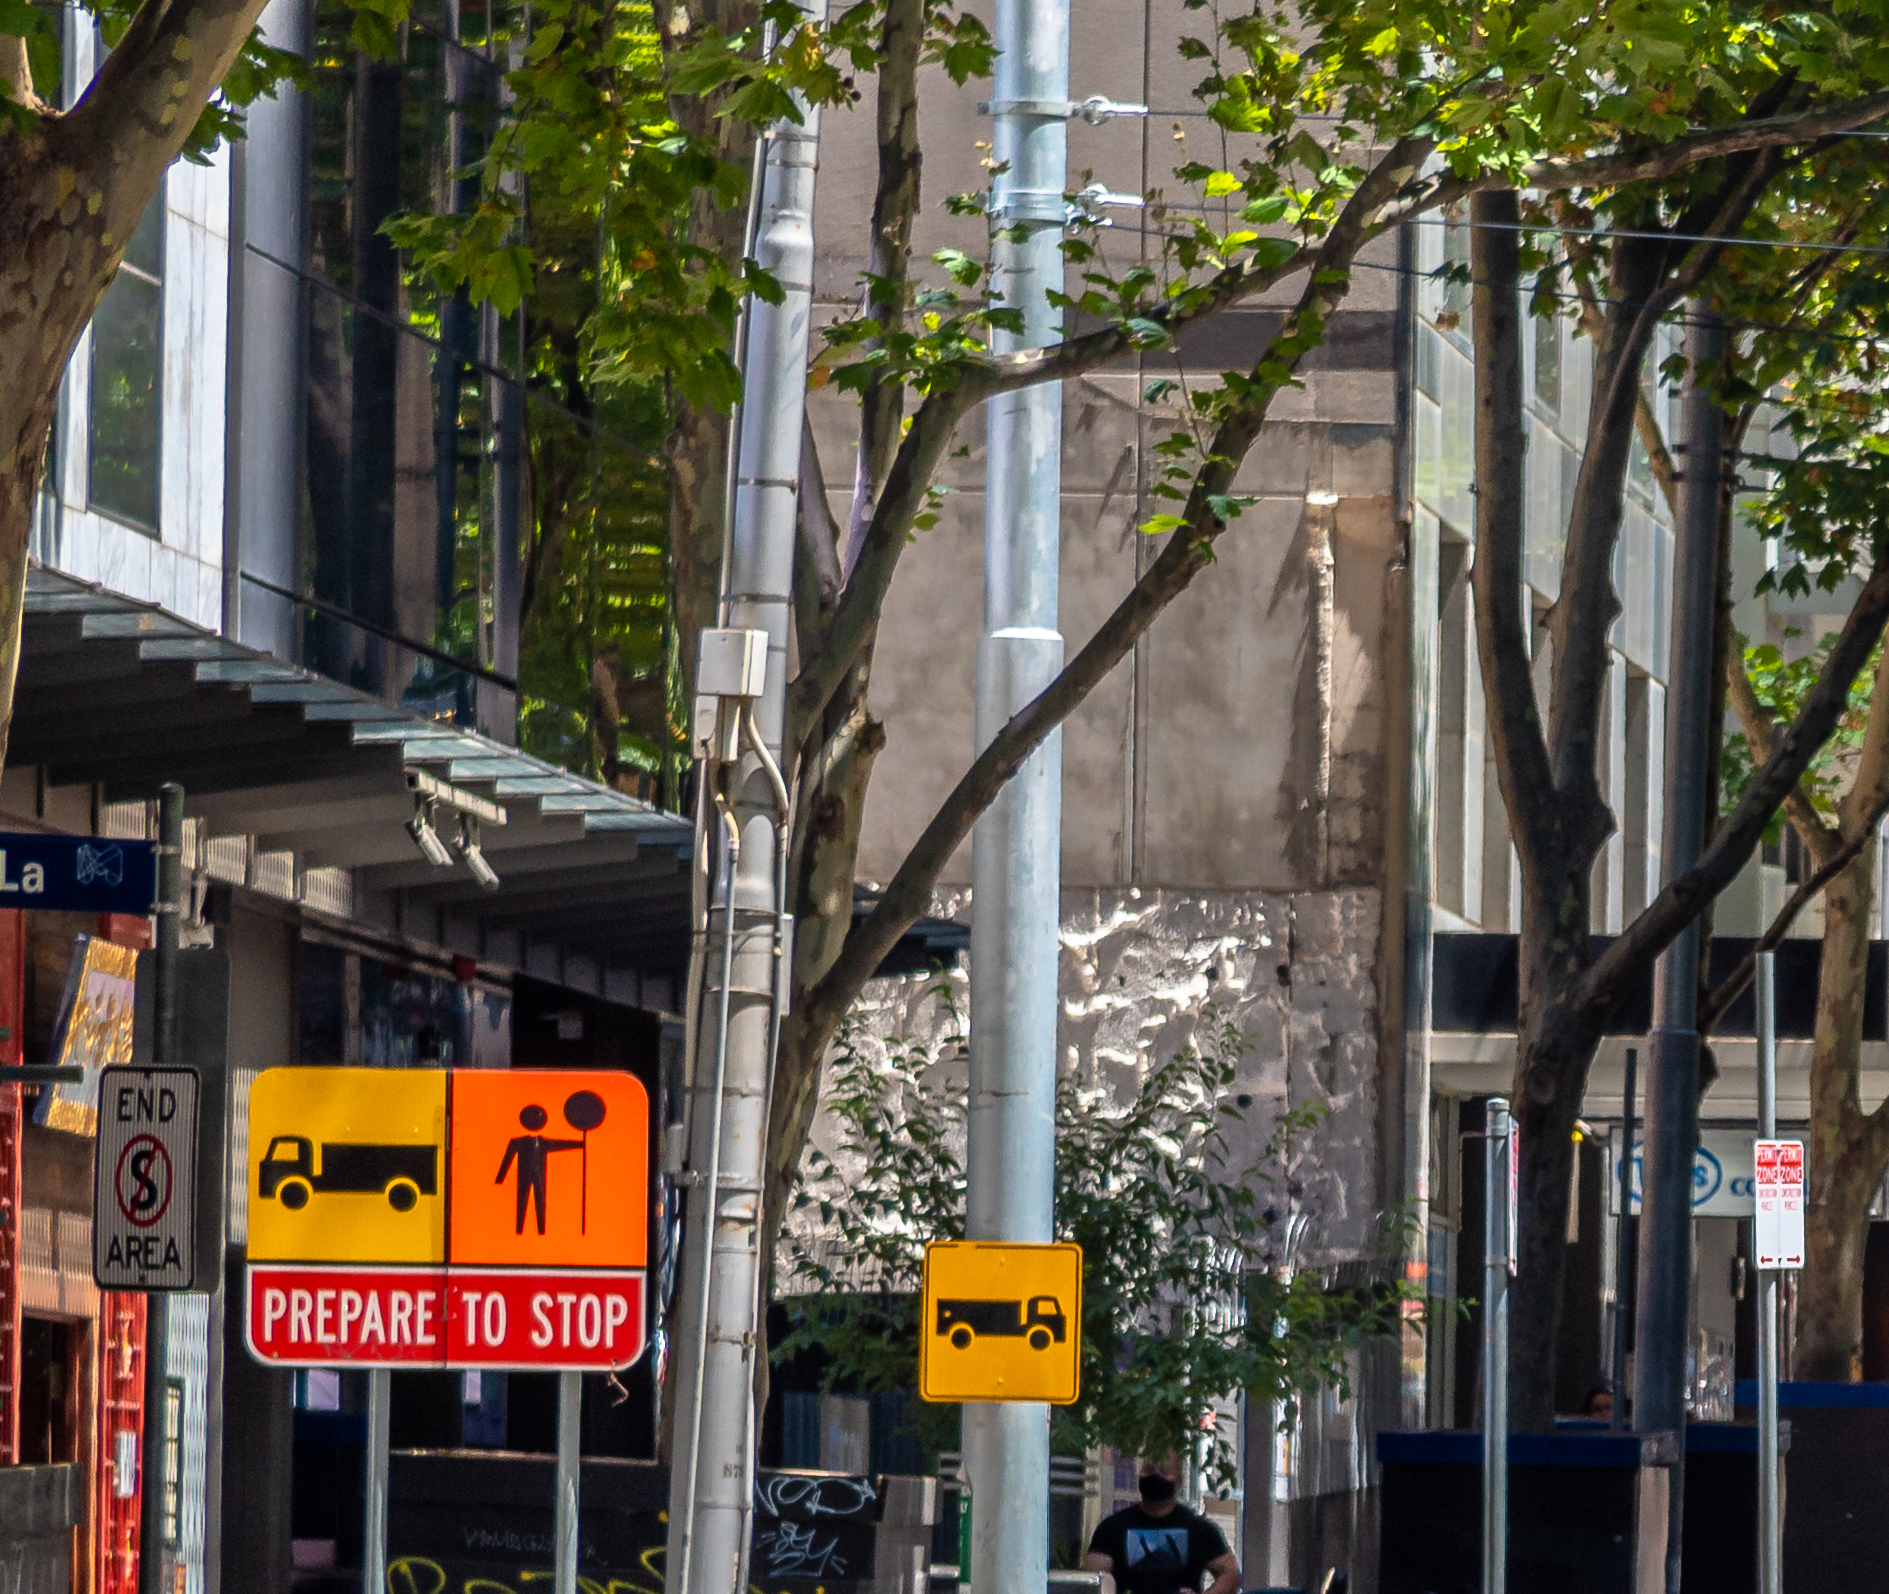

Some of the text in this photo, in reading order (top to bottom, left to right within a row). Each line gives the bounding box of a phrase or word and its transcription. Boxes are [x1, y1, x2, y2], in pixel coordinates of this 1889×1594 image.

[0, 849, 44, 893] La
[117, 1087, 176, 1122] END
[106, 1235, 181, 1270] AREA
[263, 1288, 628, 1349] PREPARE TO STOP
